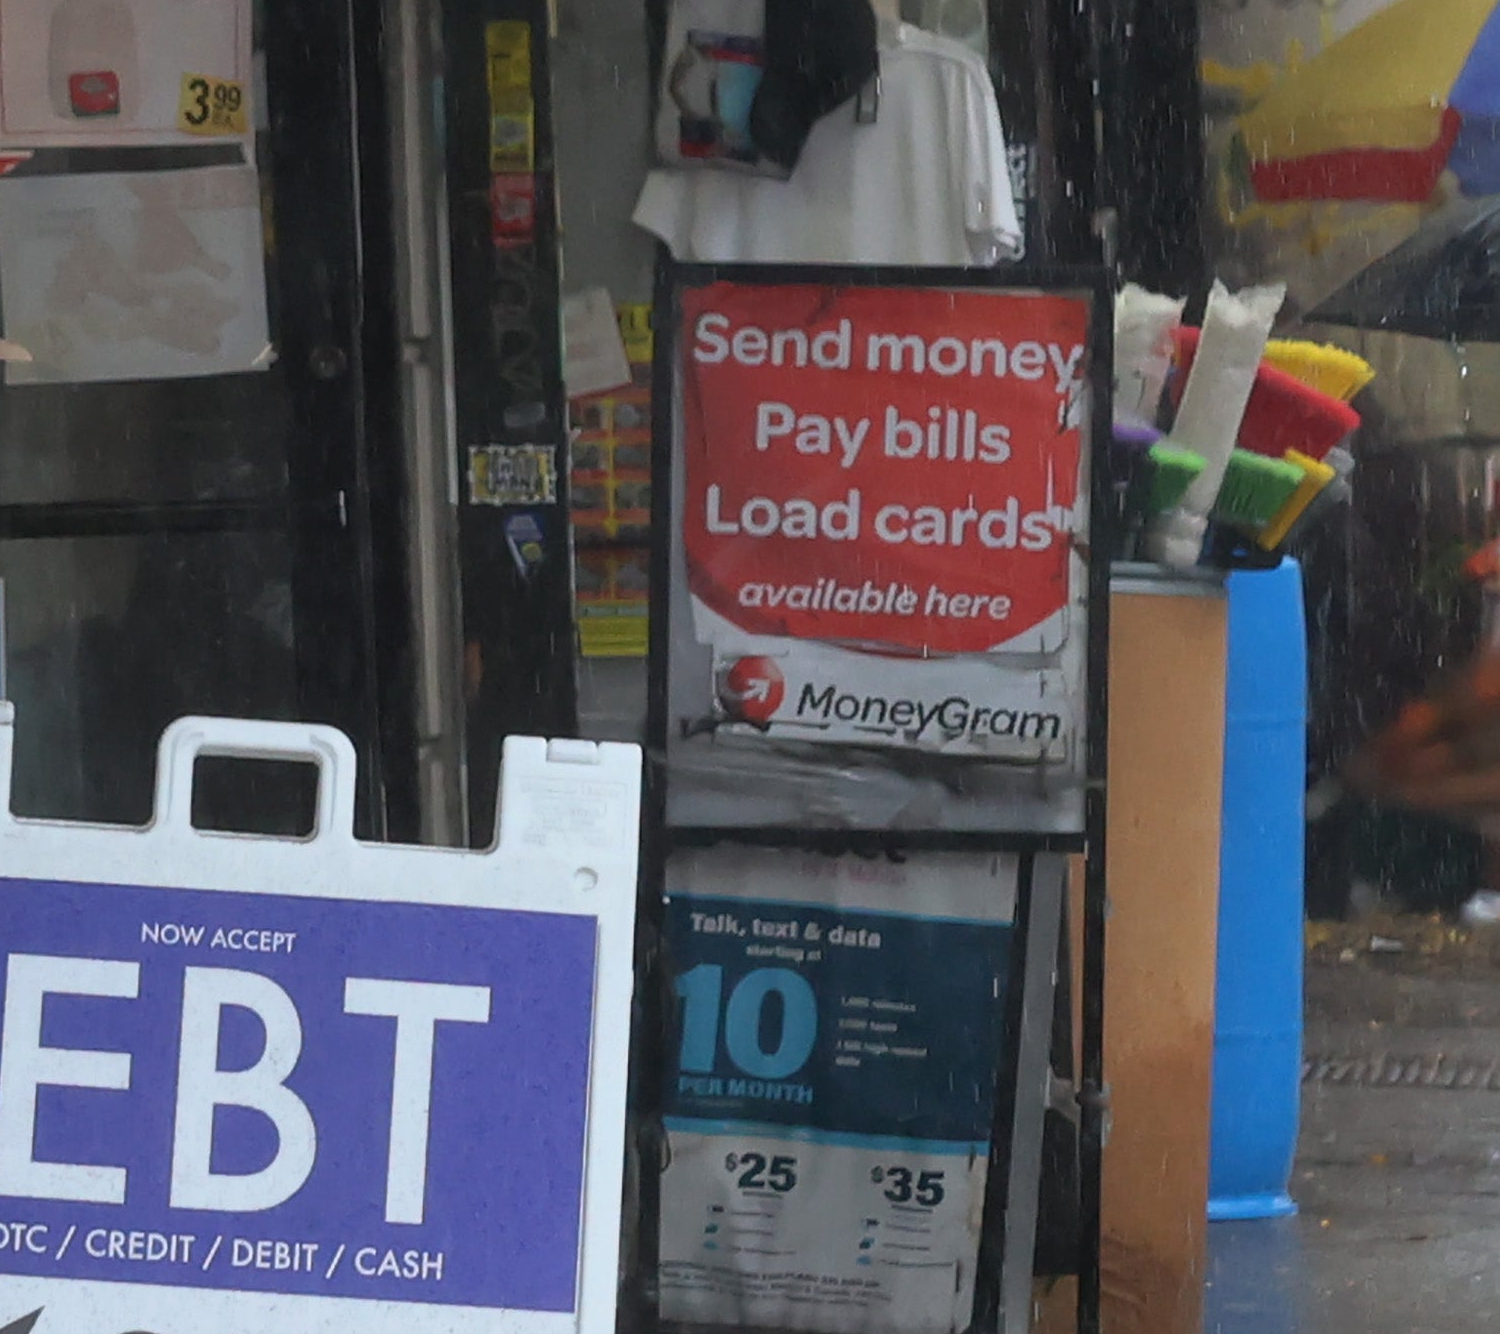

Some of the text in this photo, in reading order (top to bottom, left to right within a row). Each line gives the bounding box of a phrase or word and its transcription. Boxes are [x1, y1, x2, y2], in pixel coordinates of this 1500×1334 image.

[693, 313, 852, 370] Send
[867, 328, 1084, 395] money
[756, 402, 1011, 468] Pay bills
[705, 484, 1053, 551] Load cards
[738, 578, 1011, 621] available here
[798, 682, 1061, 740] MoneyGram
[140, 920, 297, 957] NOW ACCEPT
[690, 912, 881, 949] Talk, text & data
[674, 963, 818, 1080] 10
[678, 1074, 815, 1104] PER MONTH
[724, 1151, 798, 1193] $25
[870, 1165, 946, 1207] $35
[83, 1227, 197, 1266] CREDIT
[230, 1237, 319, 1274] DEBIT
[354, 1246, 445, 1283] CASH
